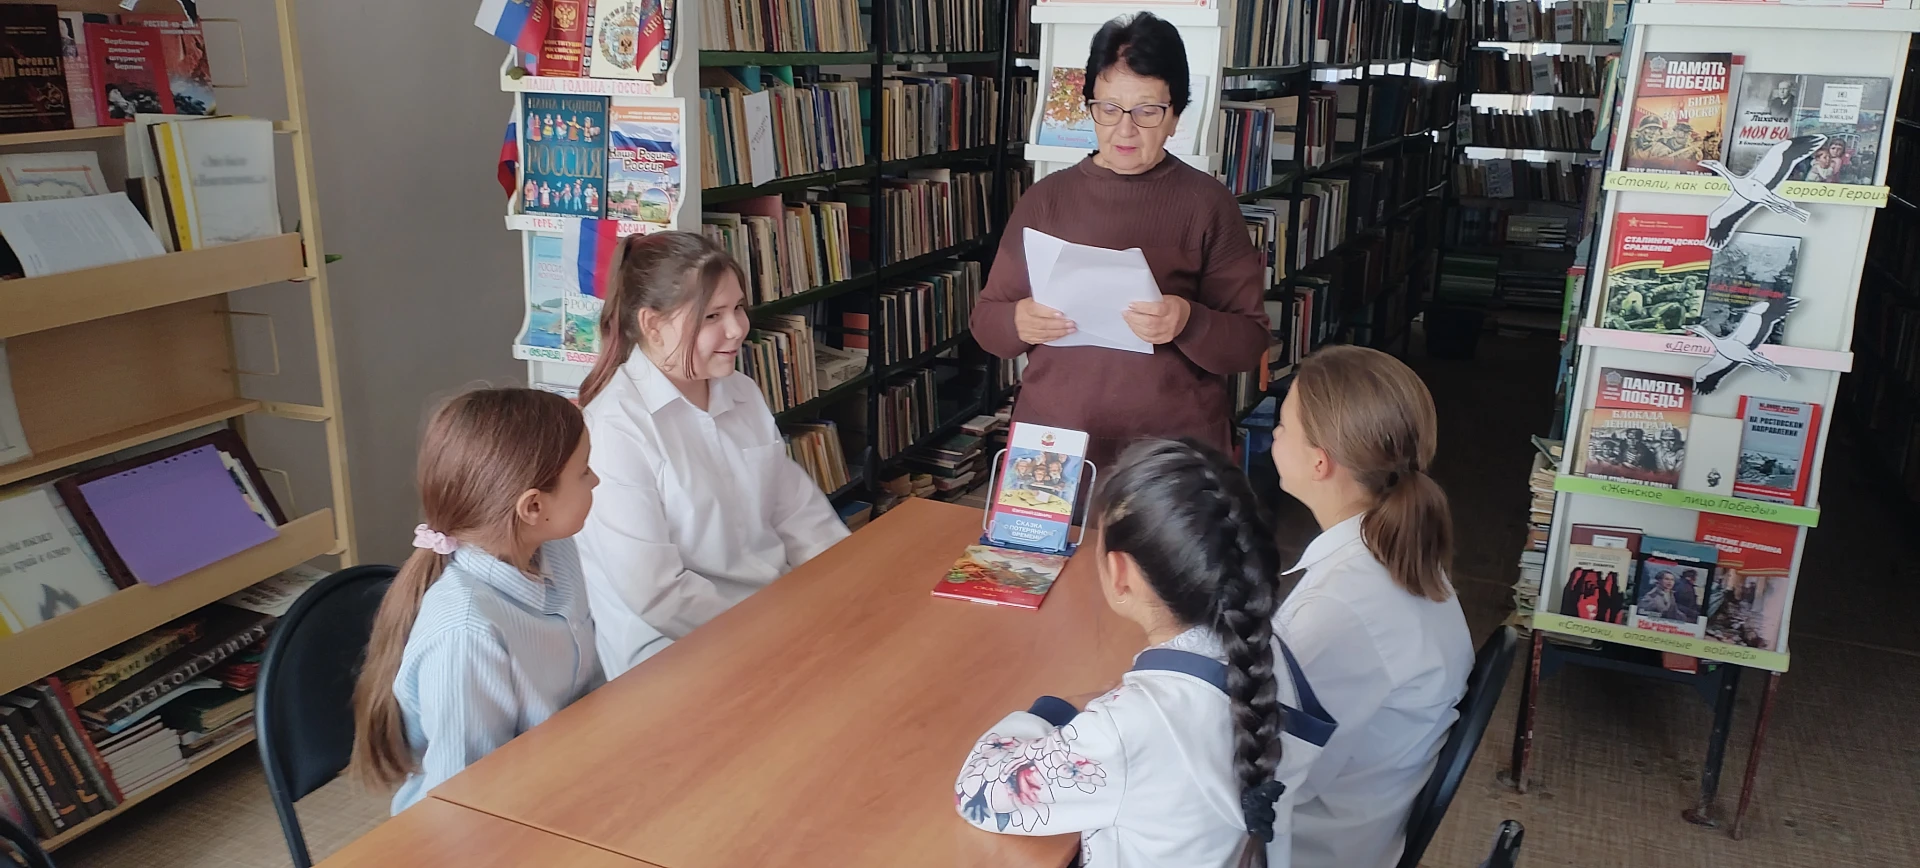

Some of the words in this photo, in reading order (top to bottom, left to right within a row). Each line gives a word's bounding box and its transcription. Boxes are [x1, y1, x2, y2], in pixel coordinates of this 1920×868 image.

[1667, 60, 1726, 75] ПАМЯТЬ
[1665, 75, 1726, 91] ПОБЕДЫ
[1688, 94, 1721, 107] БИТВА
[1739, 126, 1769, 140] МОЯ
[1770, 126, 1789, 140] ВО
[525, 142, 602, 179] РОССИЯ
[608, 148, 637, 160] Наша
[1609, 175, 1670, 190] «Стояли,
[1675, 181, 1698, 191] как
[1785, 186, 1836, 198] города
[1839, 187, 1889, 201] Герои»
[1623, 244, 1674, 253] СРАЖЕНИЕ
[1665, 341, 1711, 354] «Дети
[1622, 376, 1685, 396] ПАМЯТЬ
[1620, 389, 1685, 409] ПОБЕДЫ
[1612, 410, 1664, 420] БЛОКАДА
[1760, 417, 1804, 429] РОСТОВСКОМ
[1601, 484, 1663, 499] «Женское
[1682, 496, 1715, 507] лицо
[1718, 499, 1778, 516] Победы»
[1016, 519, 1043, 530] СКАЗКА
[203, 624, 267, 670] КНИГА
[1558, 620, 1614, 638] «Строки,
[1623, 631, 1693, 650] опаленные
[1703, 643, 1757, 661] войной»
[119, 661, 201, 715] ПОЧЕТА
